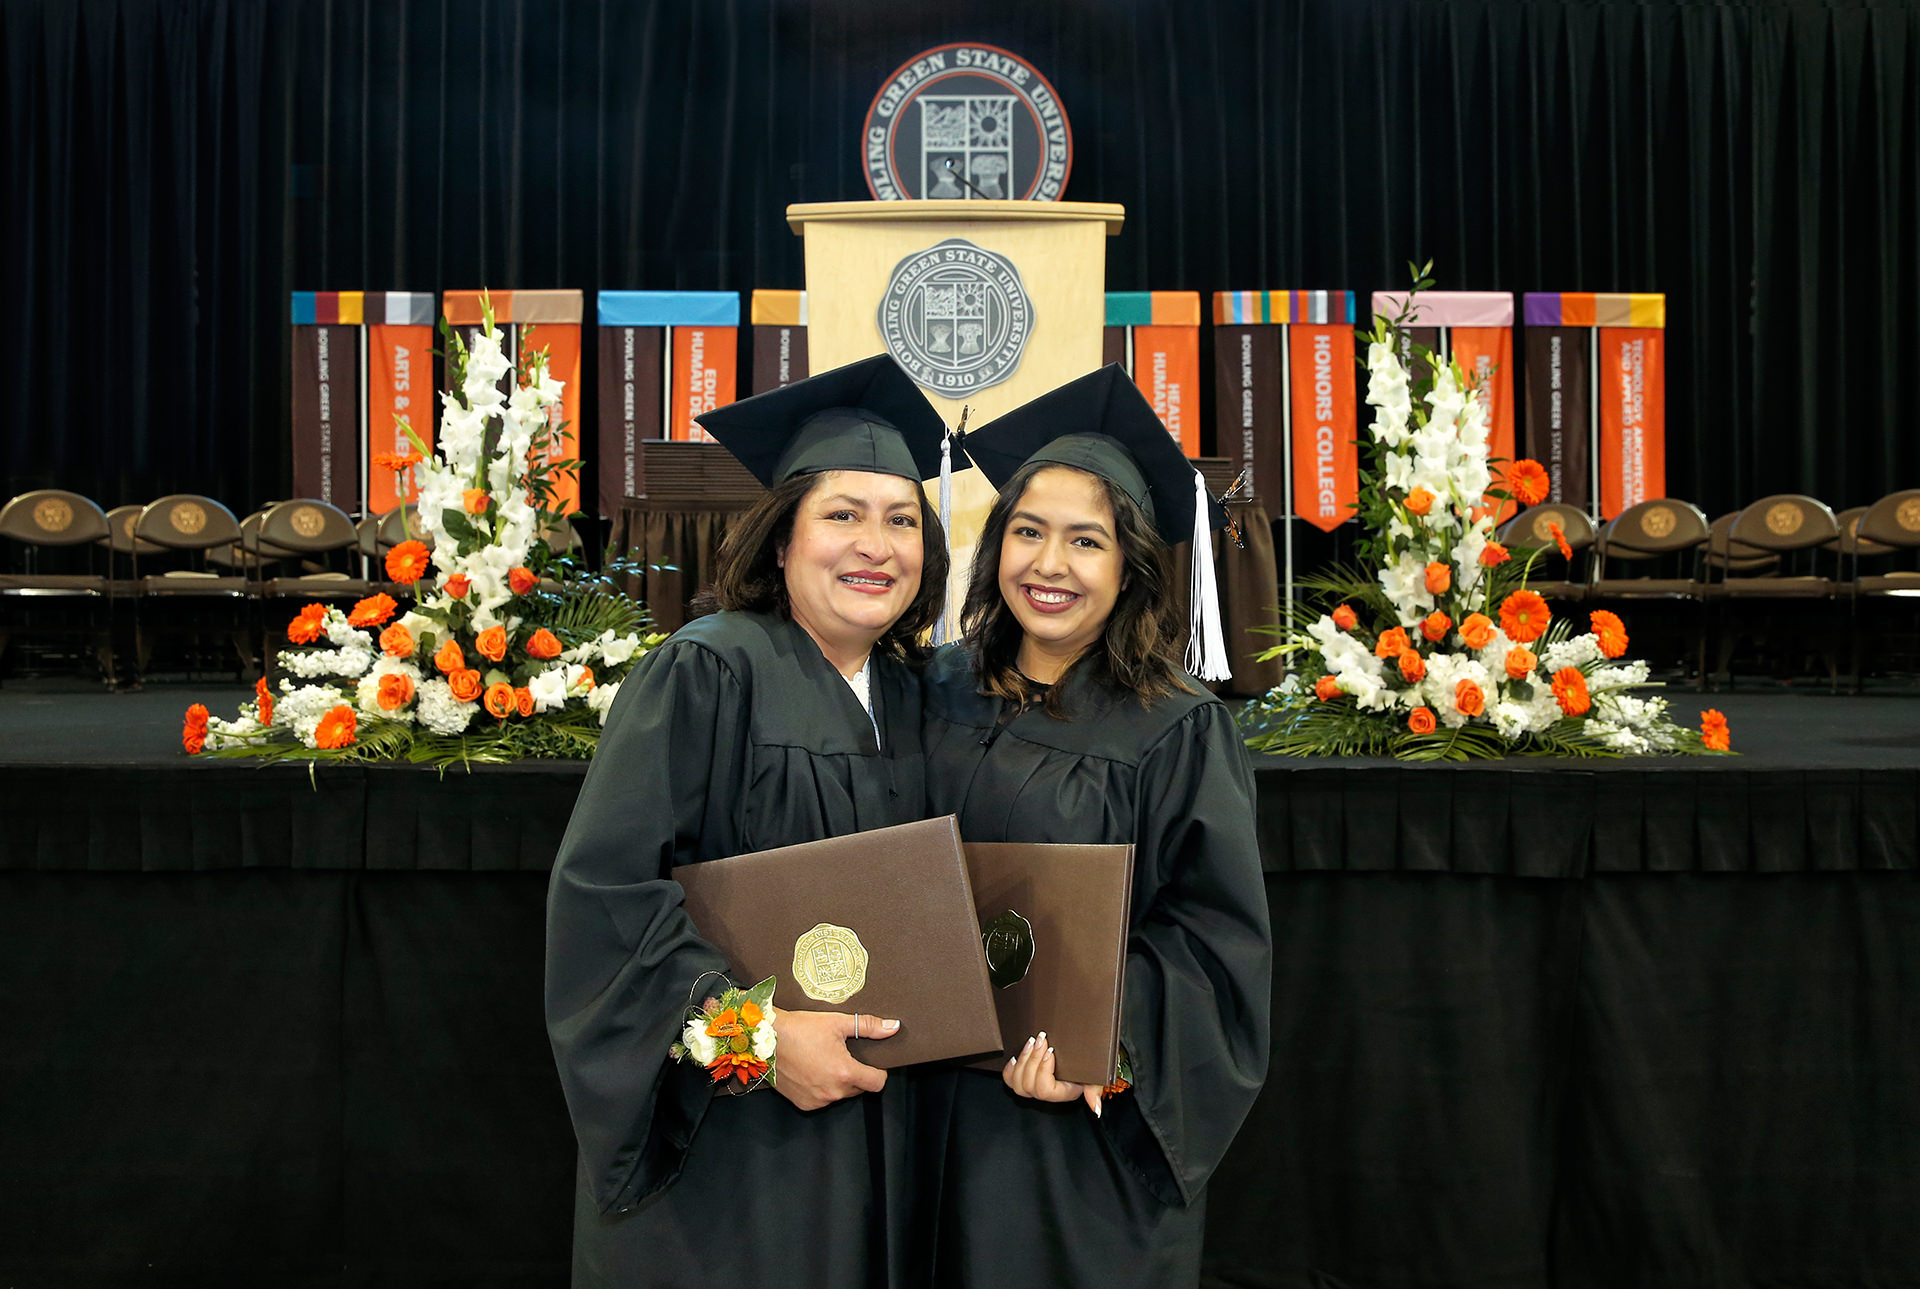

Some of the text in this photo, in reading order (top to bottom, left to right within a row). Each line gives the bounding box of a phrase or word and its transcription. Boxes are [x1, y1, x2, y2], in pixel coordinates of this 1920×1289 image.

[877, 53, 945, 117] GREEN
[956, 48, 1030, 85] STATE
[887, 250, 1024, 370] BOWLING GREEN STATE UNIVERSITY
[318, 328, 330, 381] BOWLING
[395, 345, 410, 392] ARTS
[624, 328, 634, 381] BOWLING
[690, 332, 704, 392] HUMAN
[779, 329, 790, 381] BOWLING
[1241, 334, 1253, 387] BOWLING
[1550, 336, 1562, 389] BOWLING
[1621, 342, 1632, 371] AND
[319, 384, 331, 421] GREEN
[395, 396, 410, 410] &
[624, 383, 634, 421] GREEN
[937, 373, 975, 387] 1910
[1153, 352, 1166, 415] HUMAN
[1622, 374, 1633, 426] APPLIED
[1242, 389, 1253, 428] GREEN
[1313, 335, 1336, 517] HONORS COLLEGE
[1551, 391, 1562, 430] GREEN
[320, 422, 331, 454] STATE
[624, 422, 634, 453] STATE
[1242, 429, 1254, 460] STATE
[1551, 431, 1562, 462] STATE
